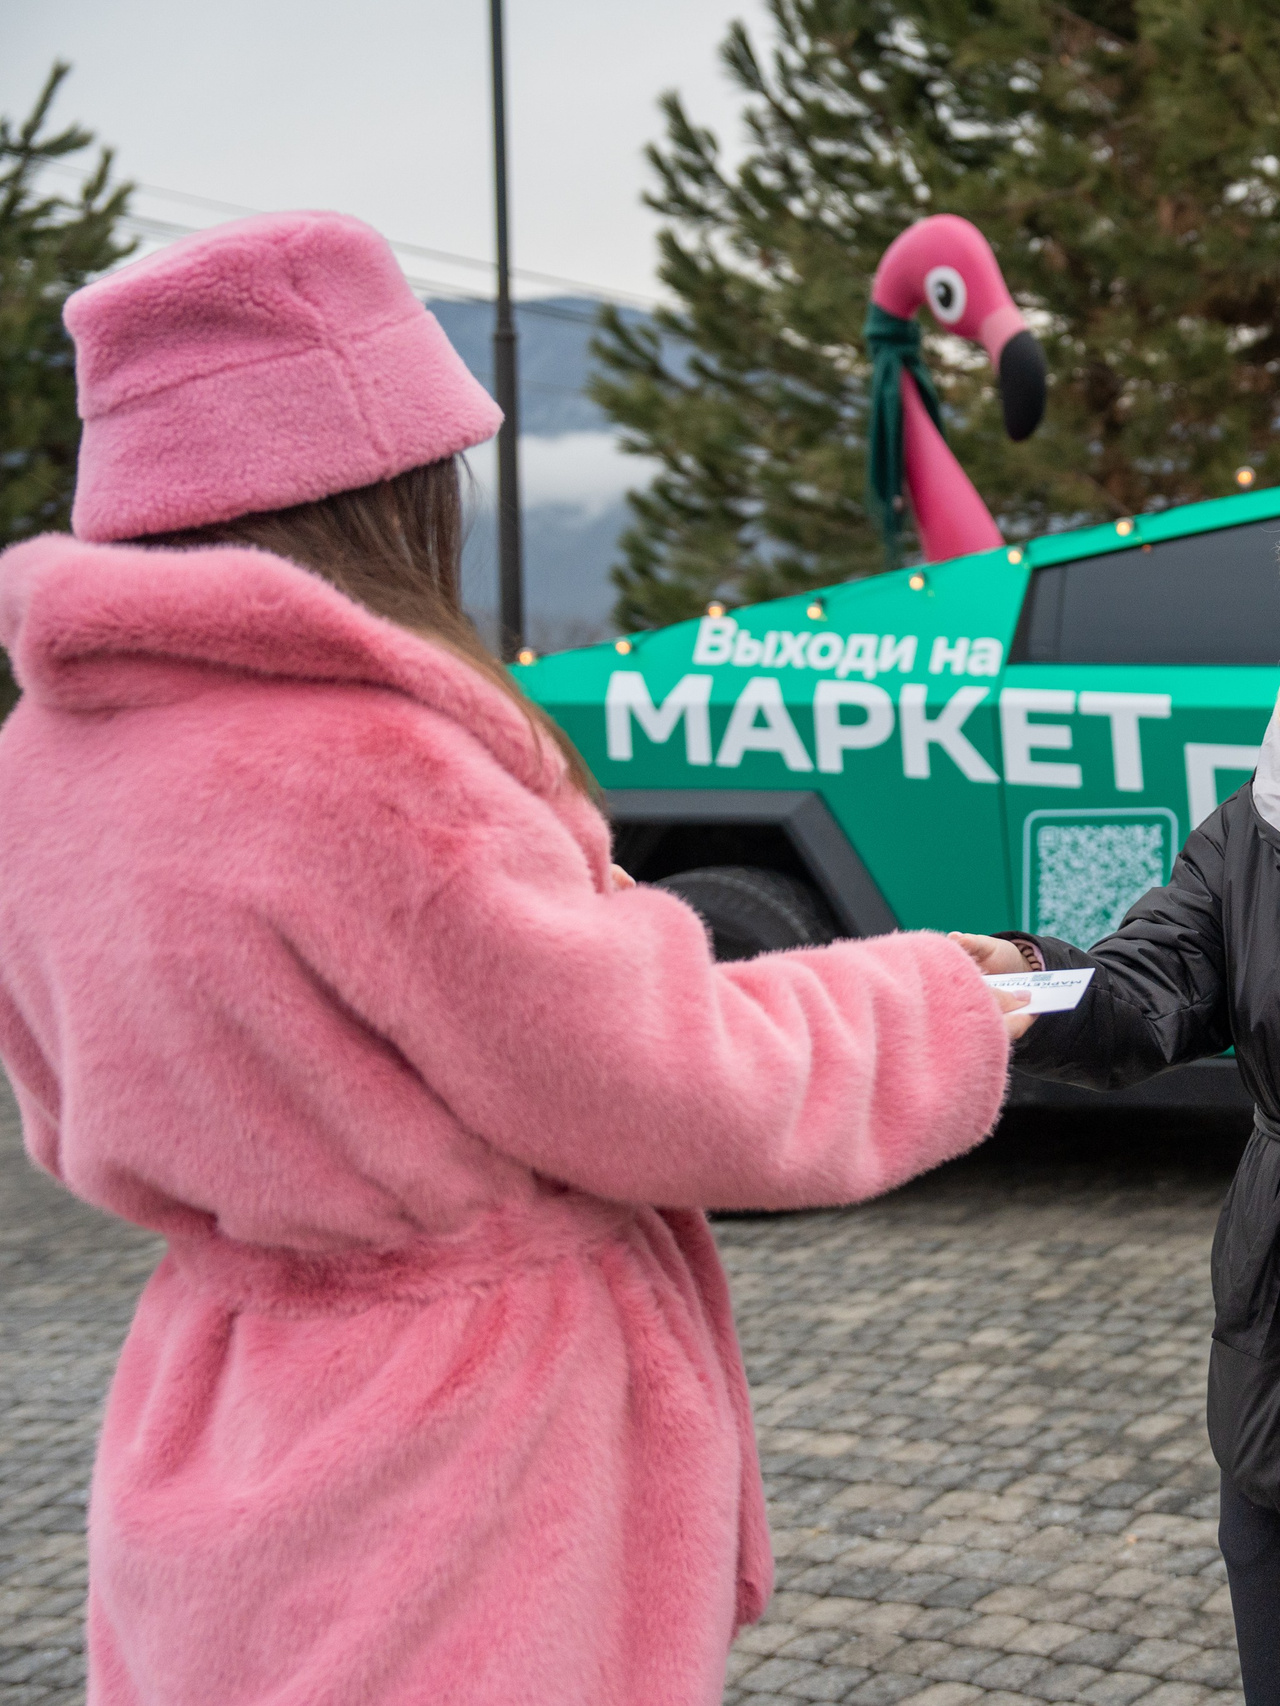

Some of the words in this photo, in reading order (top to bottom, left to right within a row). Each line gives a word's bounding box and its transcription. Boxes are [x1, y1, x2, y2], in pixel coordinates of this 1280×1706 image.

[692, 615, 918, 680] Выходи
[928, 635, 1003, 677] на
[604, 670, 1172, 792] МАРКЕТ
